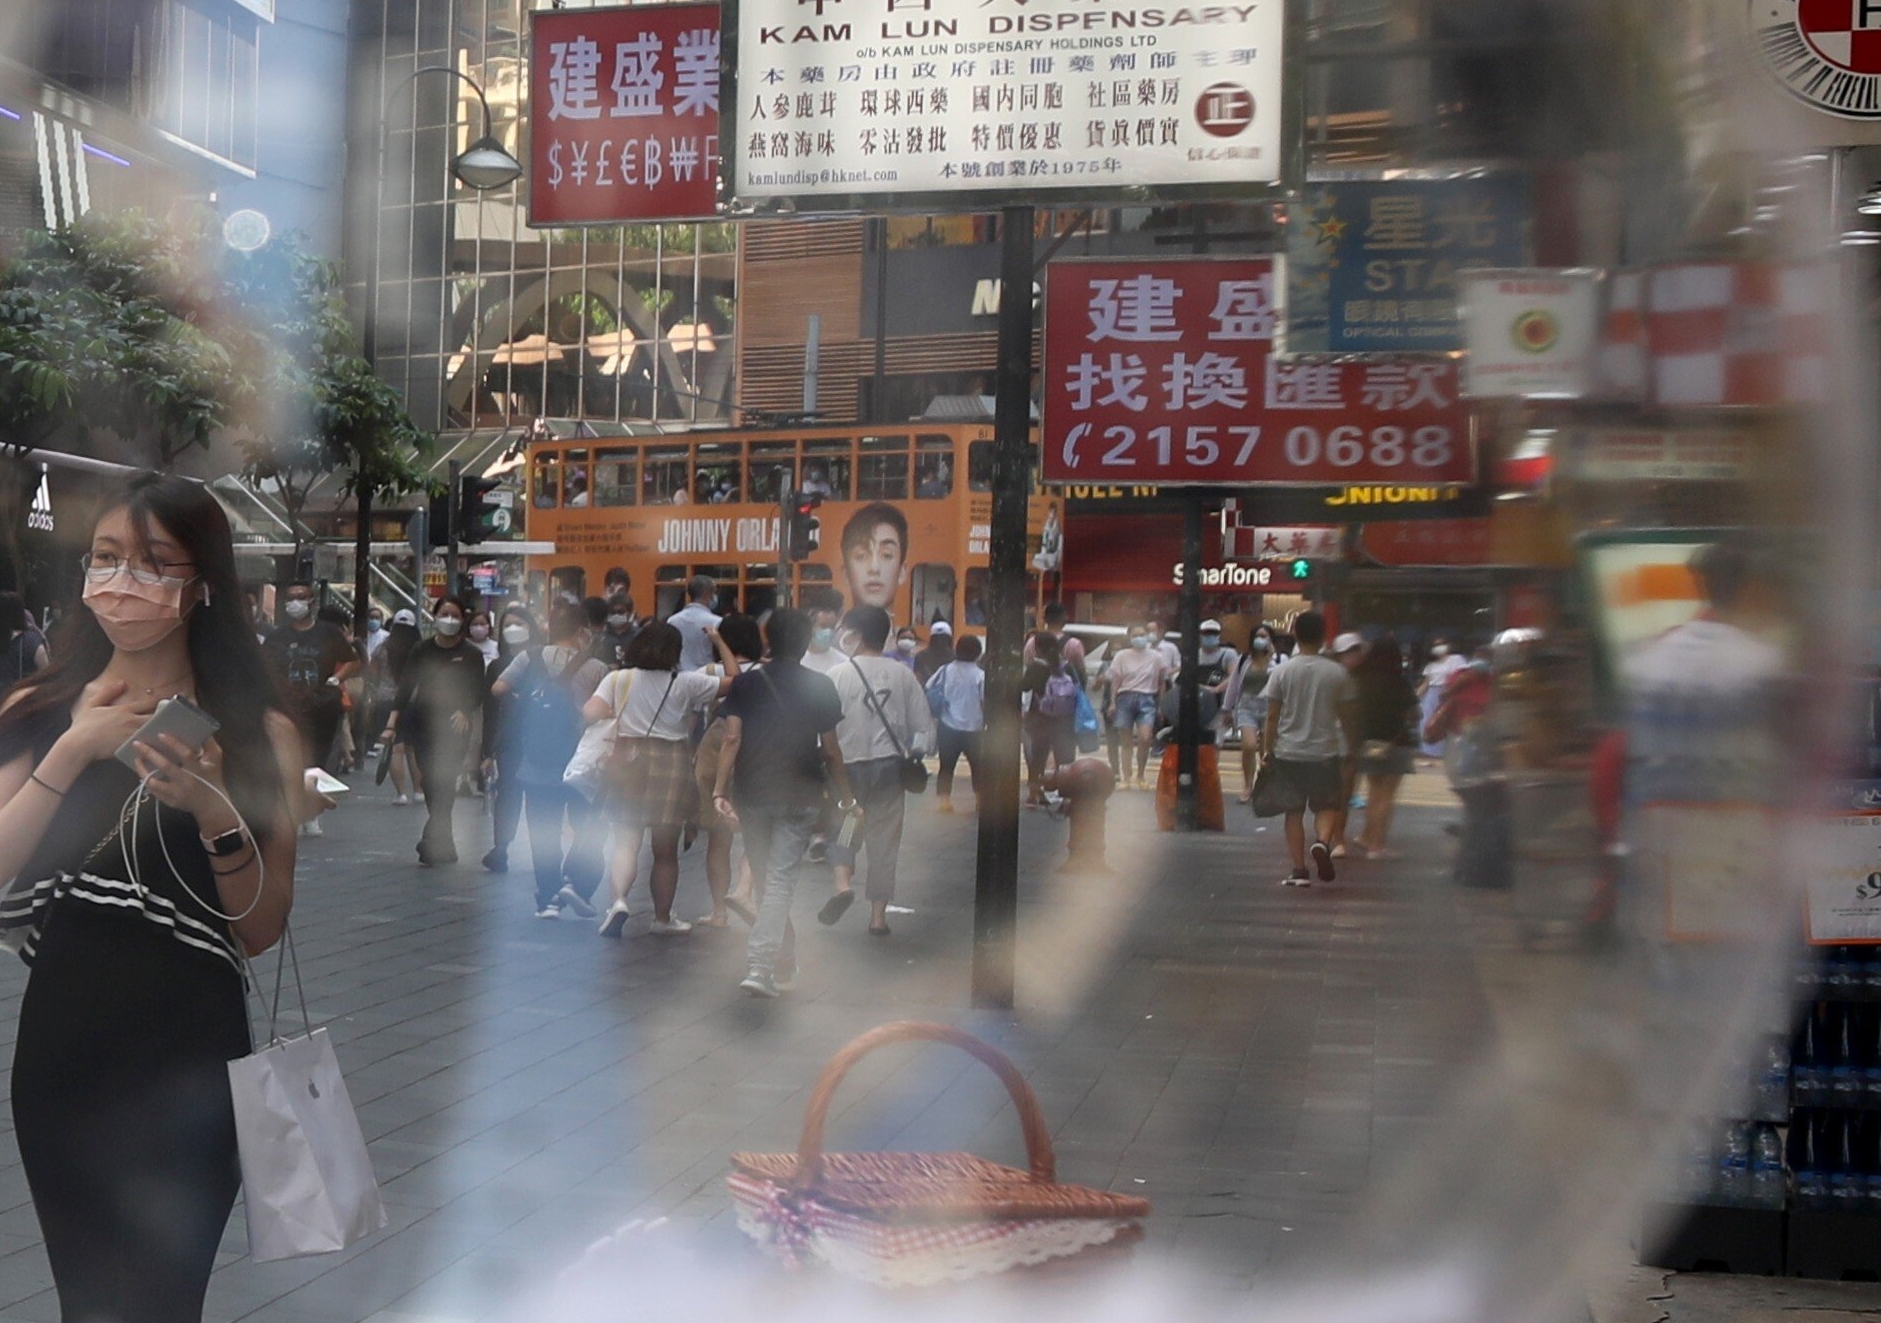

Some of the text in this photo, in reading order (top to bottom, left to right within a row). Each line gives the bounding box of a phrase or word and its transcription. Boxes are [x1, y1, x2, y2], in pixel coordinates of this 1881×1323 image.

[759, 23, 852, 44] KAM
[881, 18, 959, 39] LUN
[882, 45, 914, 58] KAM
[921, 44, 948, 56] LUN
[955, 39, 1044, 54] DISPENSARY
[1050, 35, 1124, 50] HOLDINGS
[1131, 34, 1157, 47] LTD
[548, 29, 720, 121] 建盛業
[748, 168, 898, 187] kamlundisp@hknet.com
[1065, 352, 1452, 411] 找換匯款
[1101, 425, 1453, 467] 2157 0688
[27, 511, 54, 531] adidas
[658, 518, 731, 553] JOHNNY
